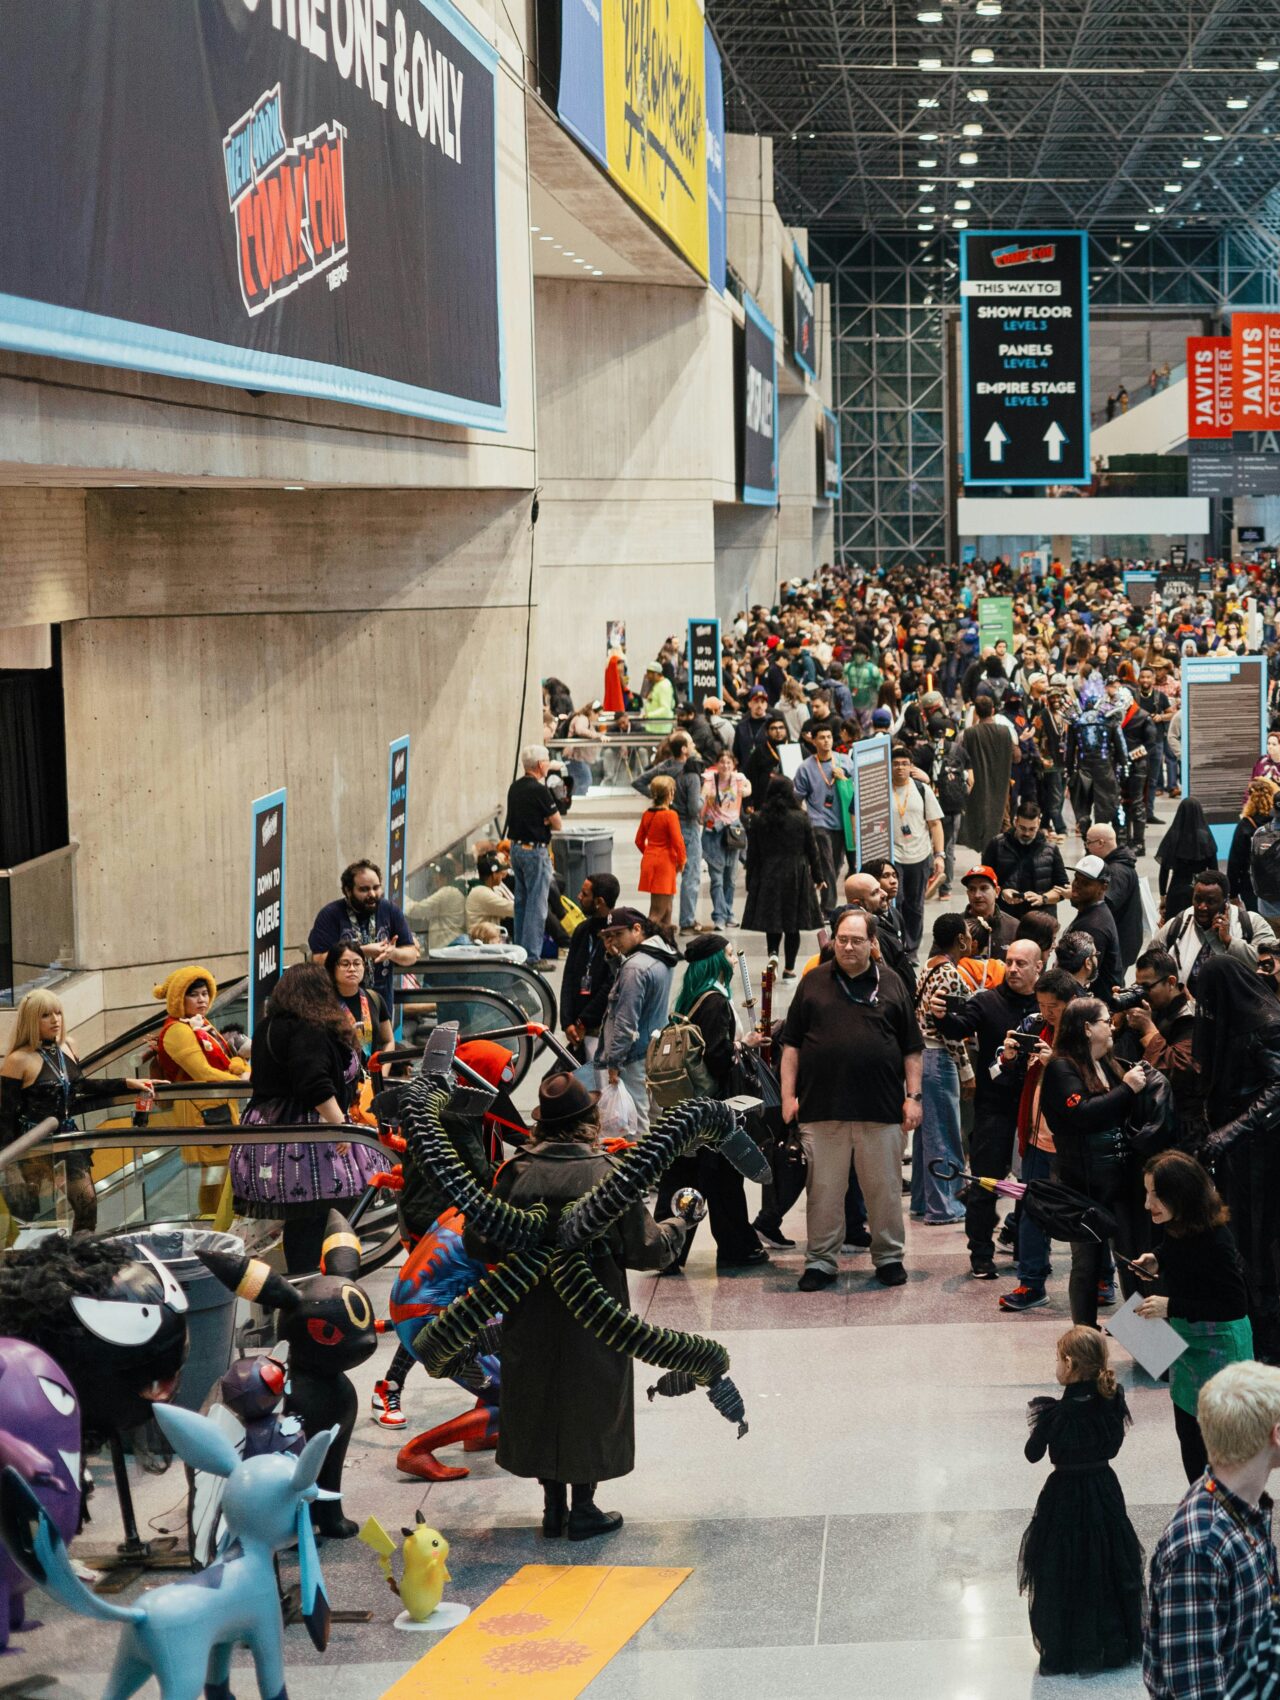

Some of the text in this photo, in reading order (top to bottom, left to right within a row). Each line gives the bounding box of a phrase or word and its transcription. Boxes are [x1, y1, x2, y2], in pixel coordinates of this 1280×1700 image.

[394, 9, 411, 127] &
[412, 30, 463, 164] ONLY
[976, 284, 1004, 293] THIS
[1008, 284, 1034, 293] WAY
[977, 306, 1073, 318] SHOW FLOOR
[1003, 320, 1038, 331] LEVEL
[998, 344, 1053, 356] PANELS
[1003, 358, 1049, 369] LEVEL 4
[1242, 327, 1263, 415] JAVITS
[976, 382, 1076, 394] EMPIRE STAGE
[1195, 350, 1214, 425] JAVITS
[1220, 350, 1233, 426] CENTER
[1004, 396, 1038, 407] LEVEL
[1248, 431, 1280, 453] 1A
[694, 659, 715, 671] SHOW
[693, 675, 717, 687] FLOOR
[257, 867, 280, 896] DOWN TO
[256, 901, 280, 939] QUEUE
[259, 945, 277, 980] HALL
